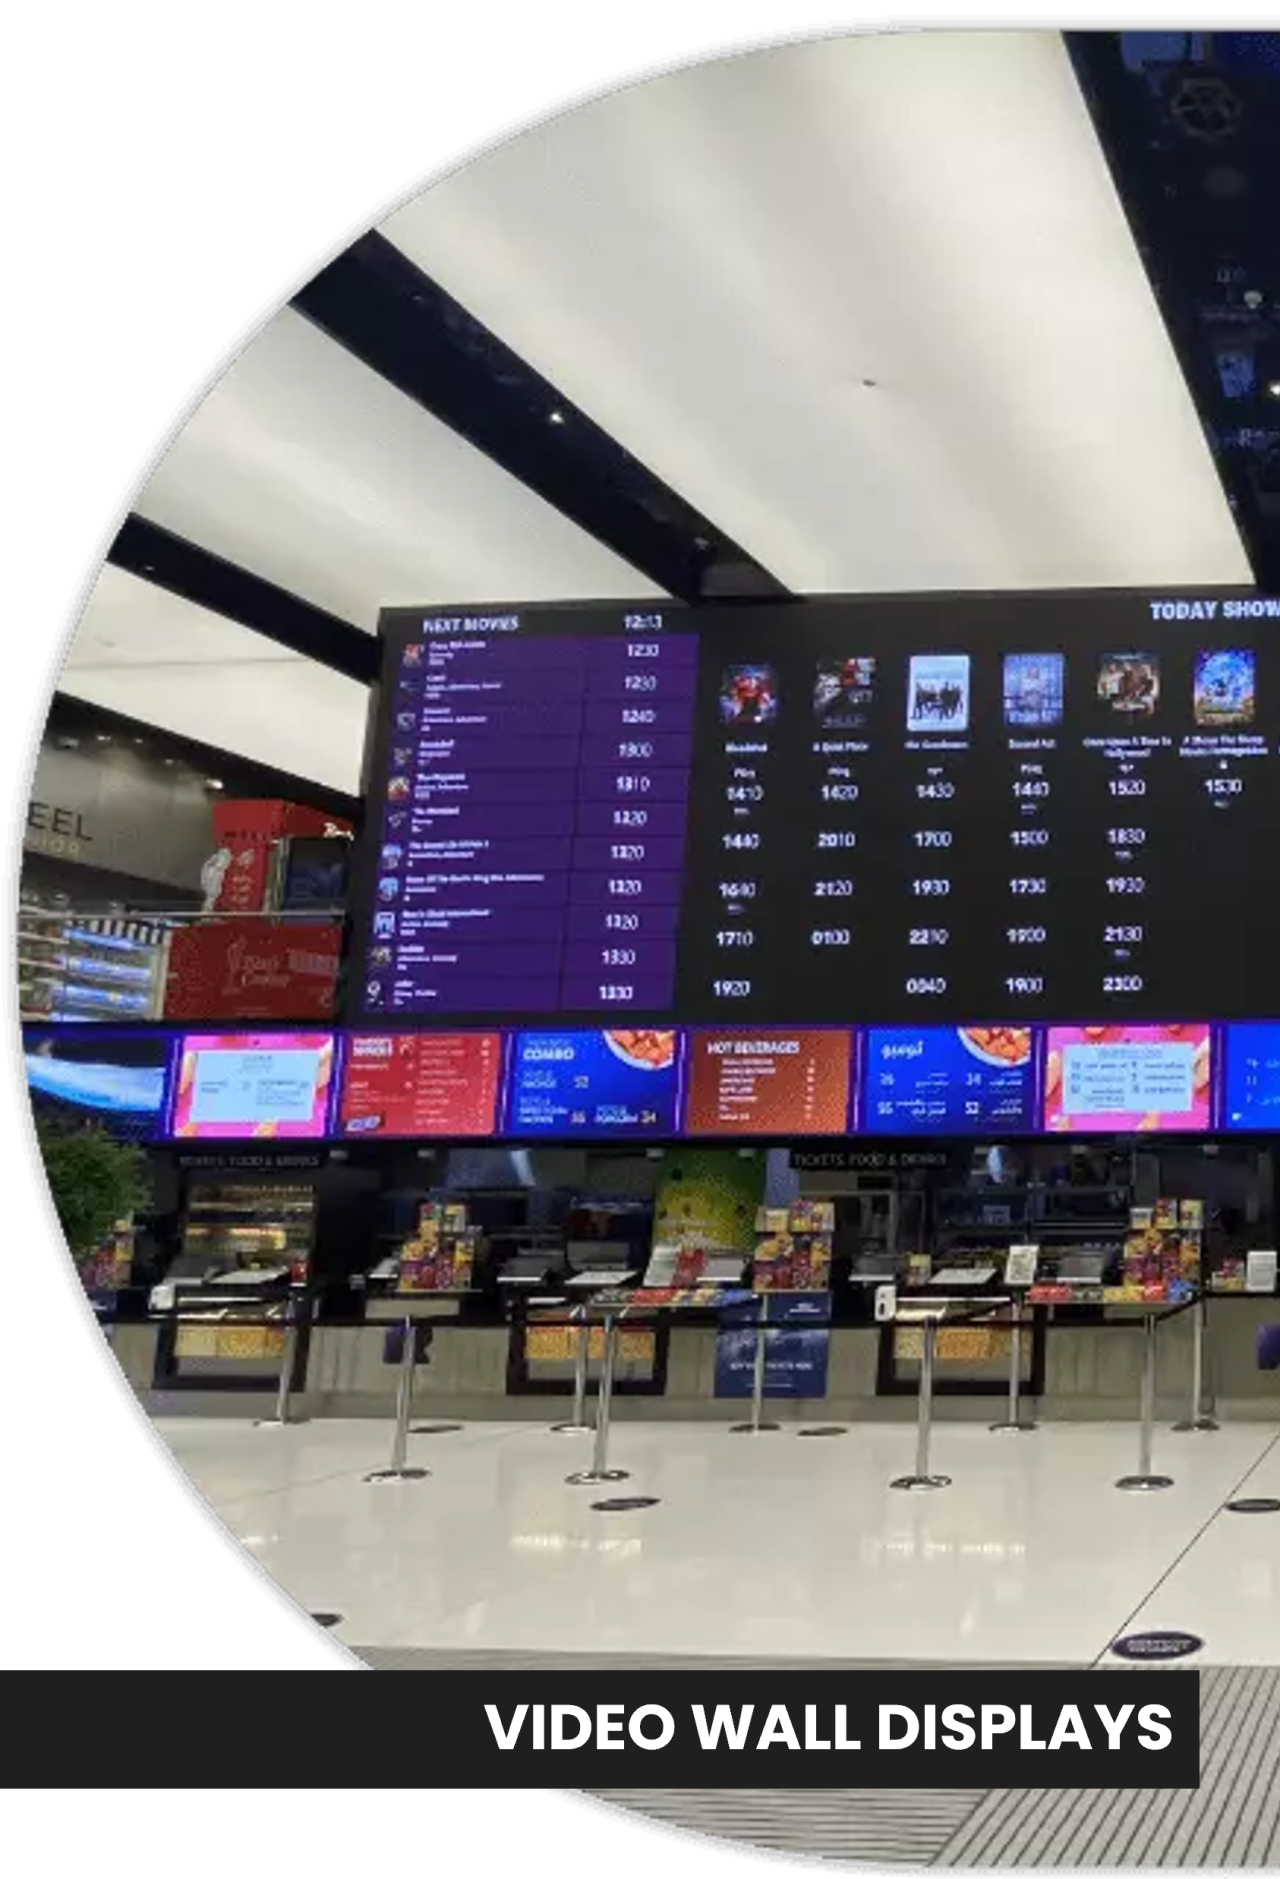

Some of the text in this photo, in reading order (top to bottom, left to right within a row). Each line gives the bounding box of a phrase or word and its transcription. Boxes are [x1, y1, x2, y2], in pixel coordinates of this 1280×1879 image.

[1150, 602, 1217, 620] TODAY
[423, 618, 461, 634] NEXT
[818, 832, 856, 848] 2010
[913, 831, 952, 847] 1700
[1107, 828, 1145, 844] 1830
[814, 880, 853, 896] 2120
[912, 879, 950, 895] 1930
[1009, 878, 1047, 894] 1730
[1106, 877, 1145, 893] 1930
[716, 930, 753, 947] 1710
[1103, 926, 1142, 942] 2130
[713, 980, 751, 996] 1920
[523, 1047, 574, 1060] COMBO
